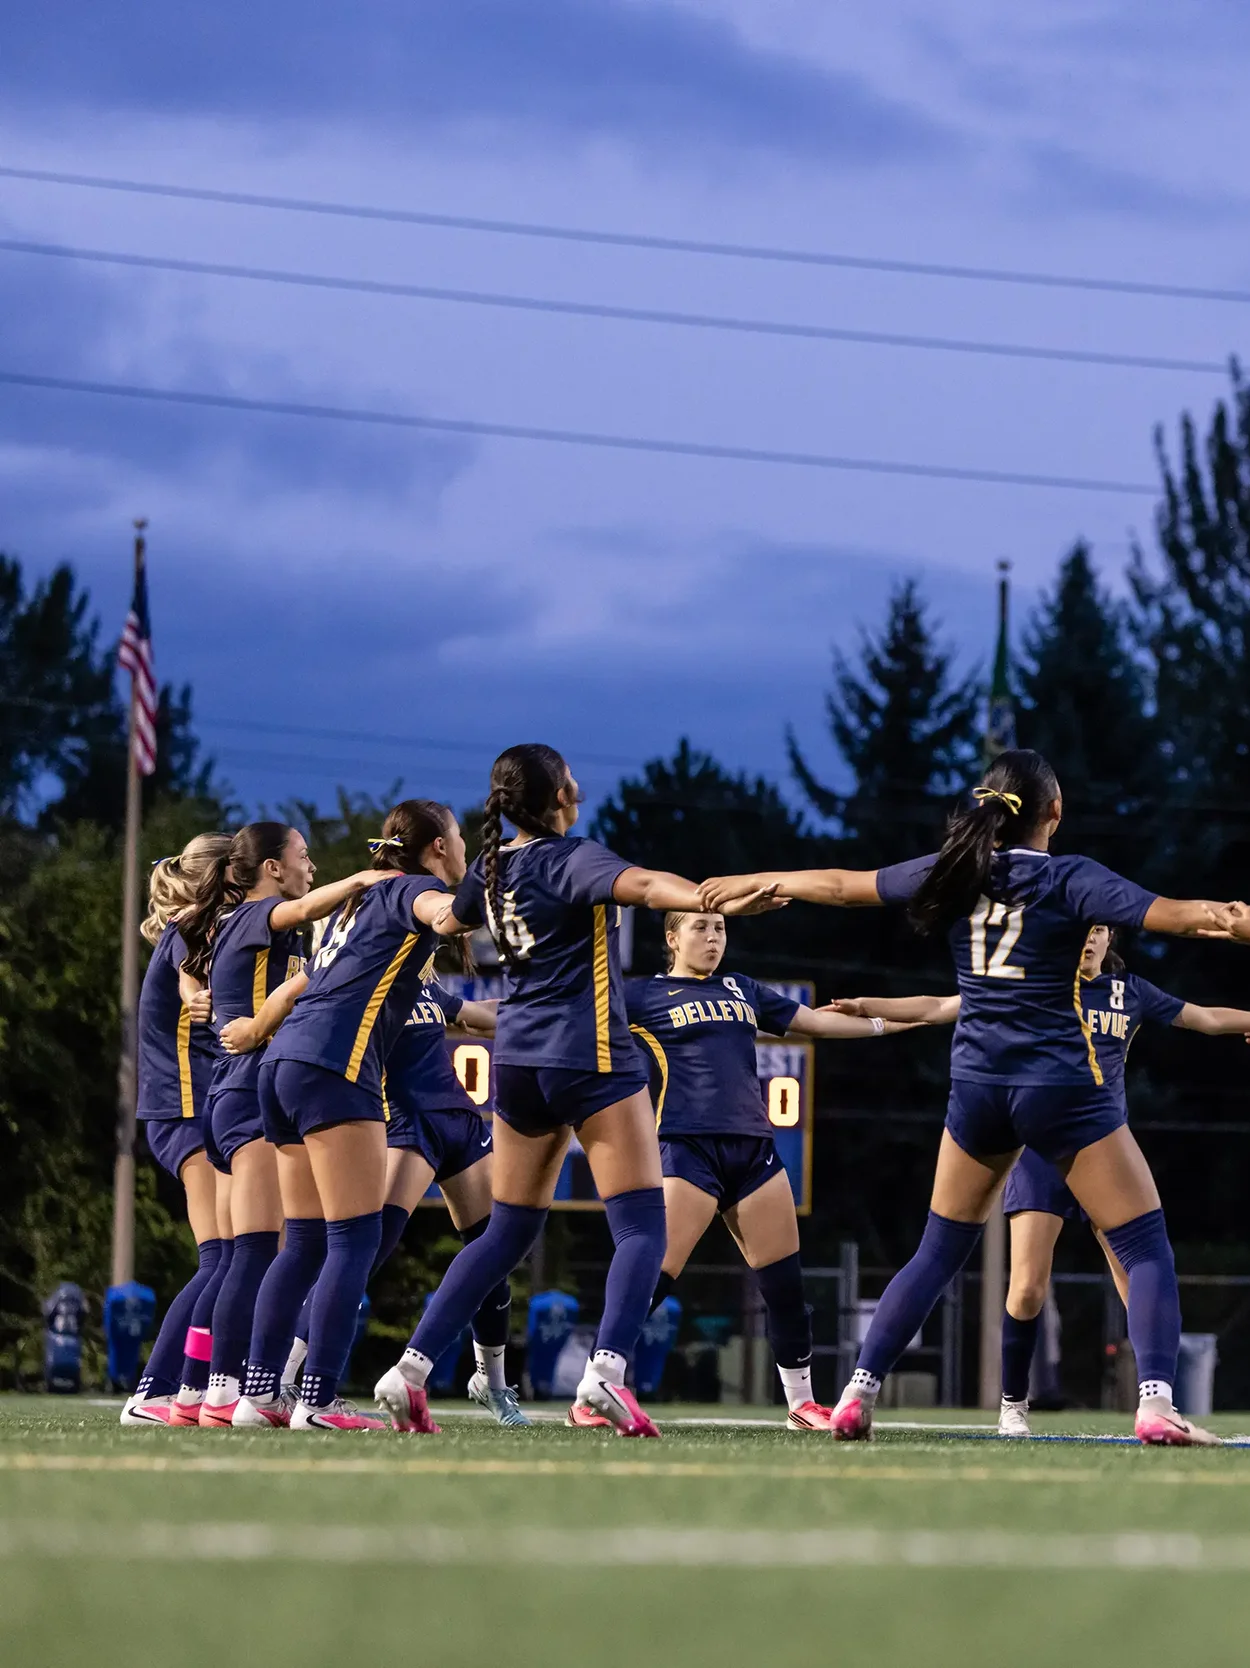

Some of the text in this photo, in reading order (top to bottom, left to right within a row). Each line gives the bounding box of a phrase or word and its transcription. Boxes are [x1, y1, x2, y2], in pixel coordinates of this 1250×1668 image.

[969, 893, 1026, 980] 12
[722, 976, 746, 1001] 9
[1109, 979, 1125, 1010] 8
[668, 1000, 758, 1029] BELLEVU
[768, 1076, 800, 1127] 0
